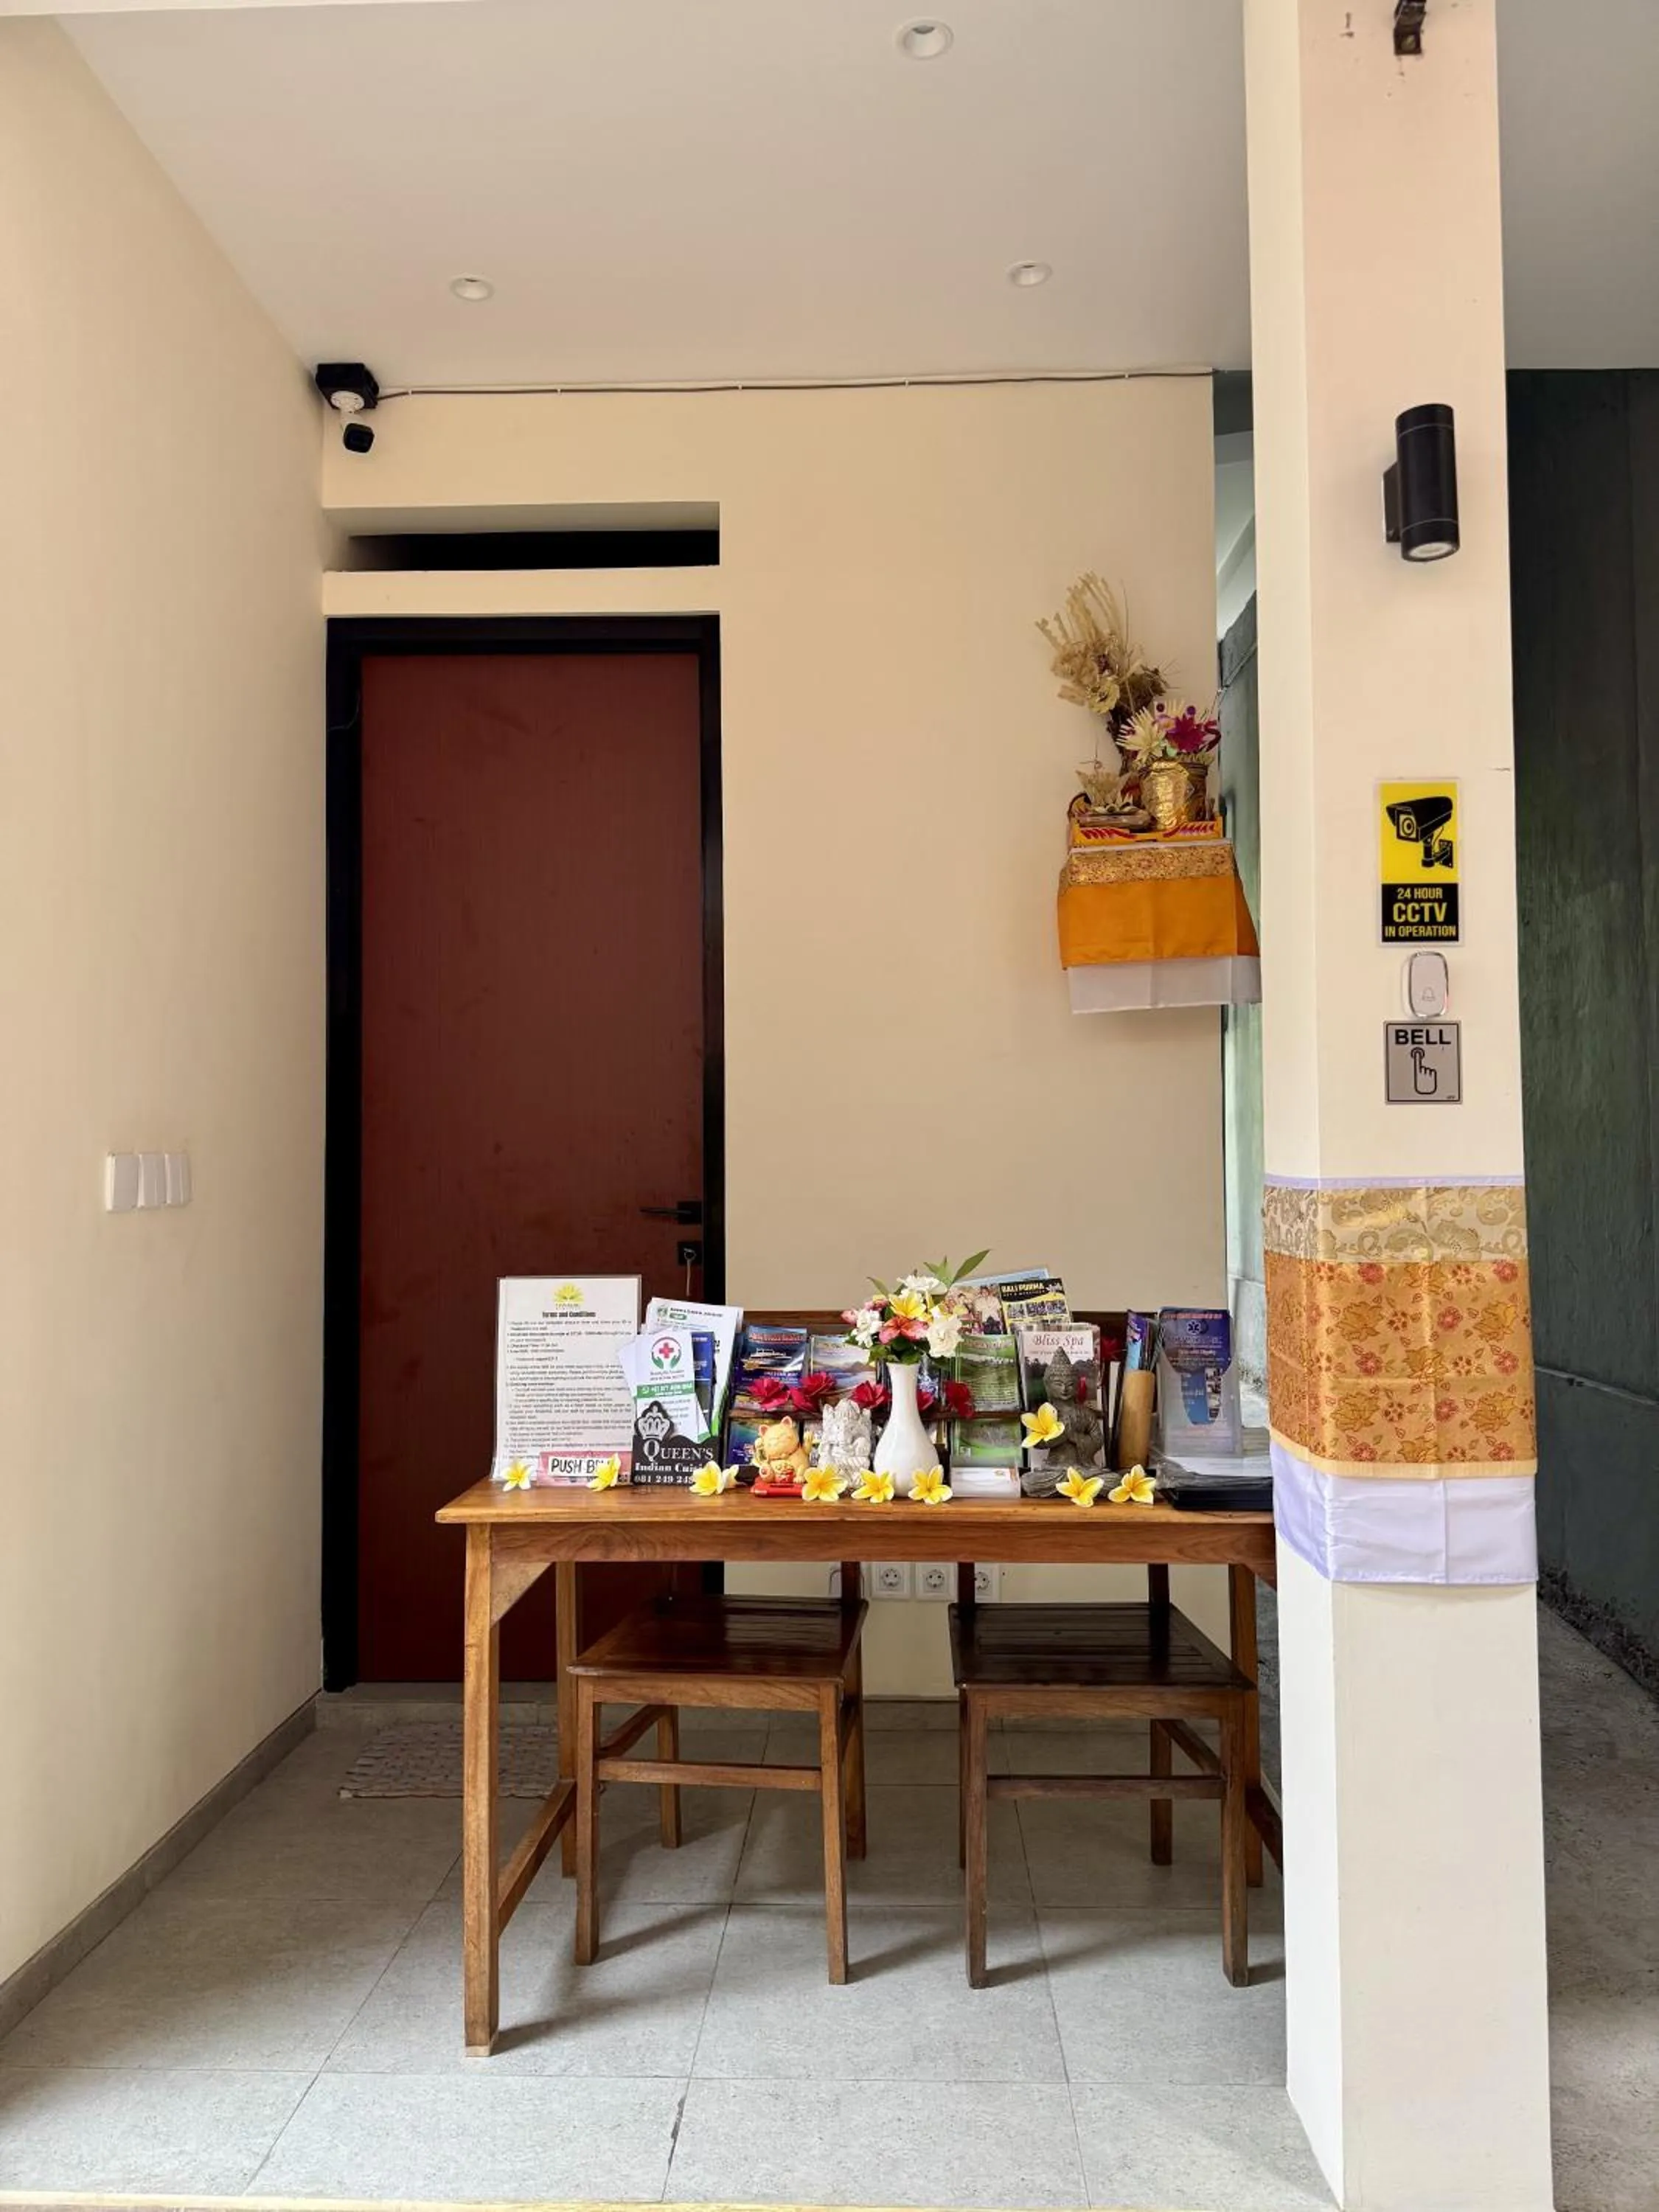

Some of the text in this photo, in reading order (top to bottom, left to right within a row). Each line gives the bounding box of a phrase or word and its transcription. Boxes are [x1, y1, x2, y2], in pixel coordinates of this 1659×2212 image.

[1397, 887, 1444, 900] 24 HOUR
[1393, 902, 1447, 922] CCTV
[1384, 925, 1457, 937] IN OPERATION
[1394, 1029, 1452, 1045] BELL
[1032, 1332, 1060, 1346] Bliss
[1062, 1333, 1085, 1350] Spa
[551, 1458, 582, 1474] PUSH
[635, 1462, 672, 1472] Indian
[634, 1475, 652, 1484] 081
